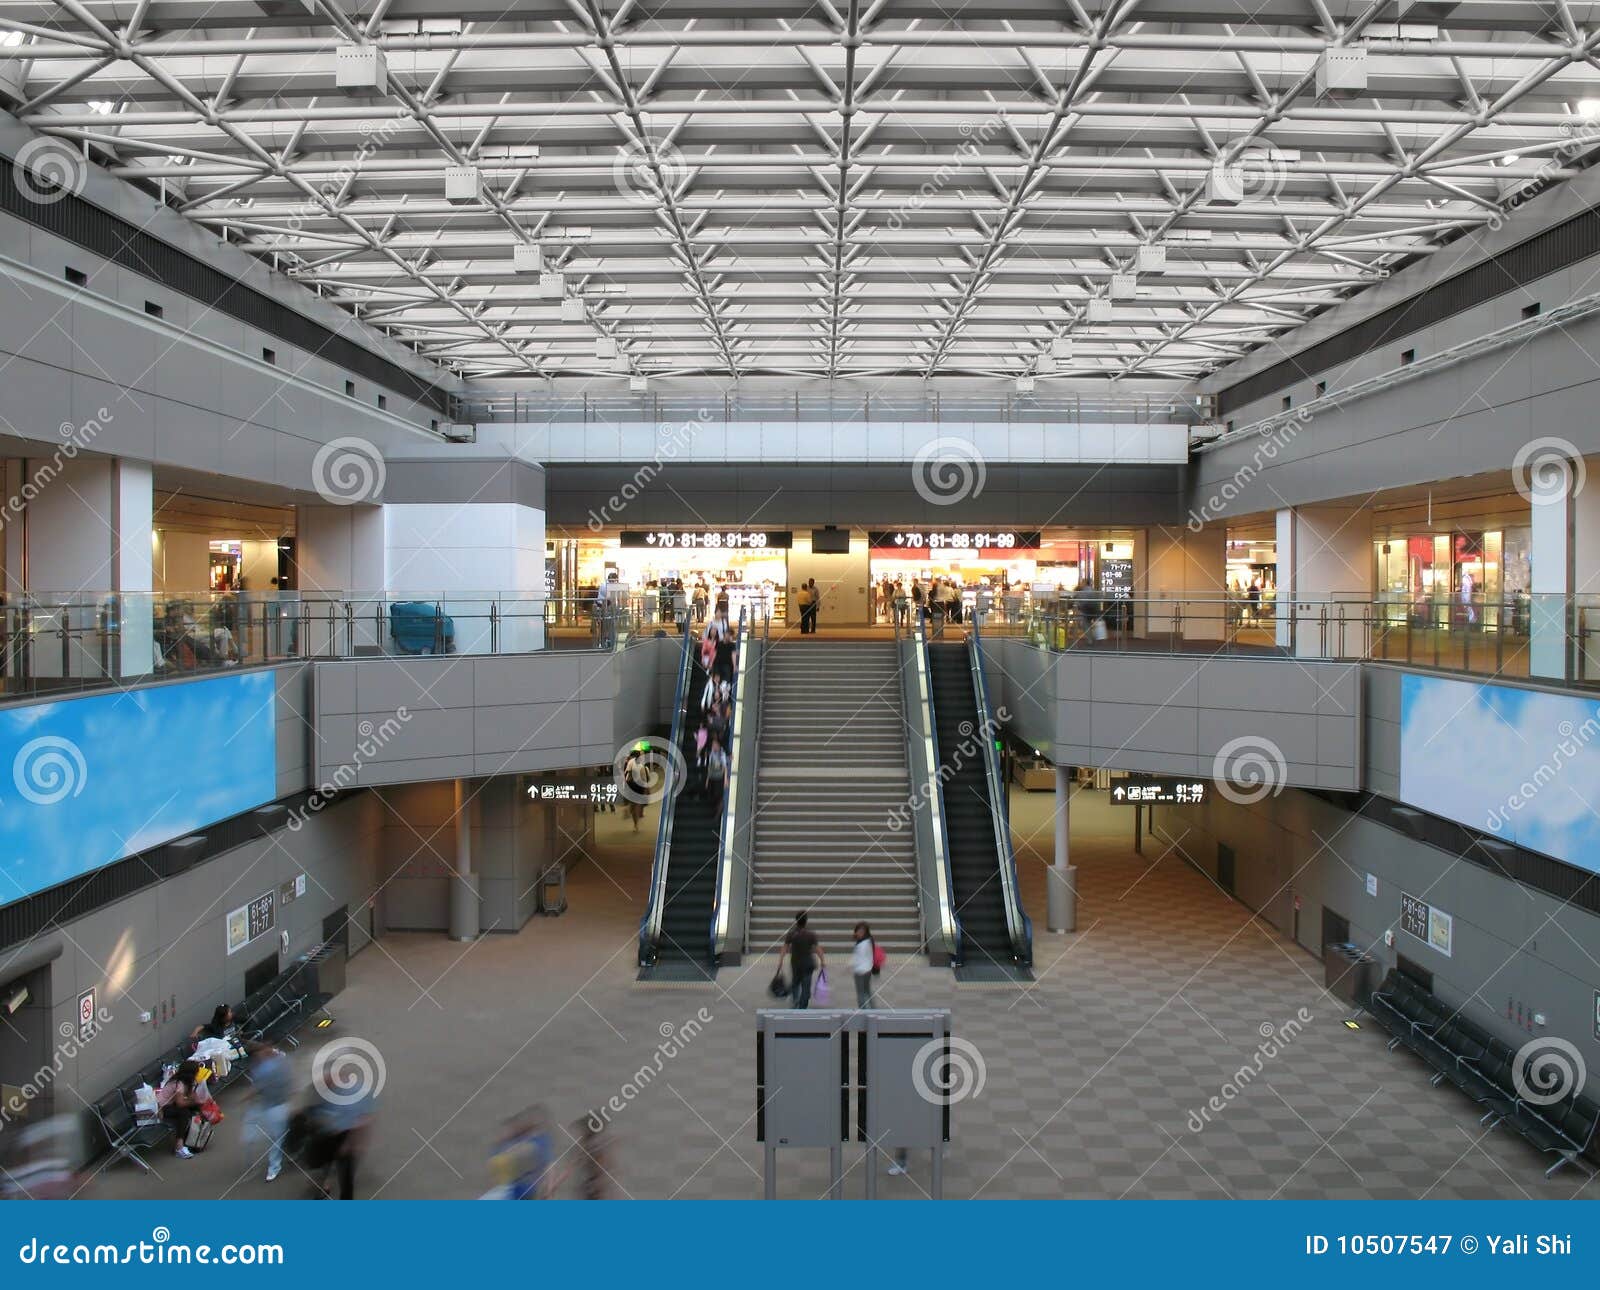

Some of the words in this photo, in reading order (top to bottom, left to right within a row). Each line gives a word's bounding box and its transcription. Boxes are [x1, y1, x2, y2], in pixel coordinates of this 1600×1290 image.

[591, 783, 618, 793] 61-66
[1176, 783, 1203, 793] 61-66
[591, 793, 617, 802] 71-77
[1176, 794, 1202, 803] 71-77
[251, 898, 269, 919] 61-66
[1407, 899, 1426, 921] 61-66
[252, 914, 269, 936] 71-77
[1407, 915, 1425, 937] 71-77
